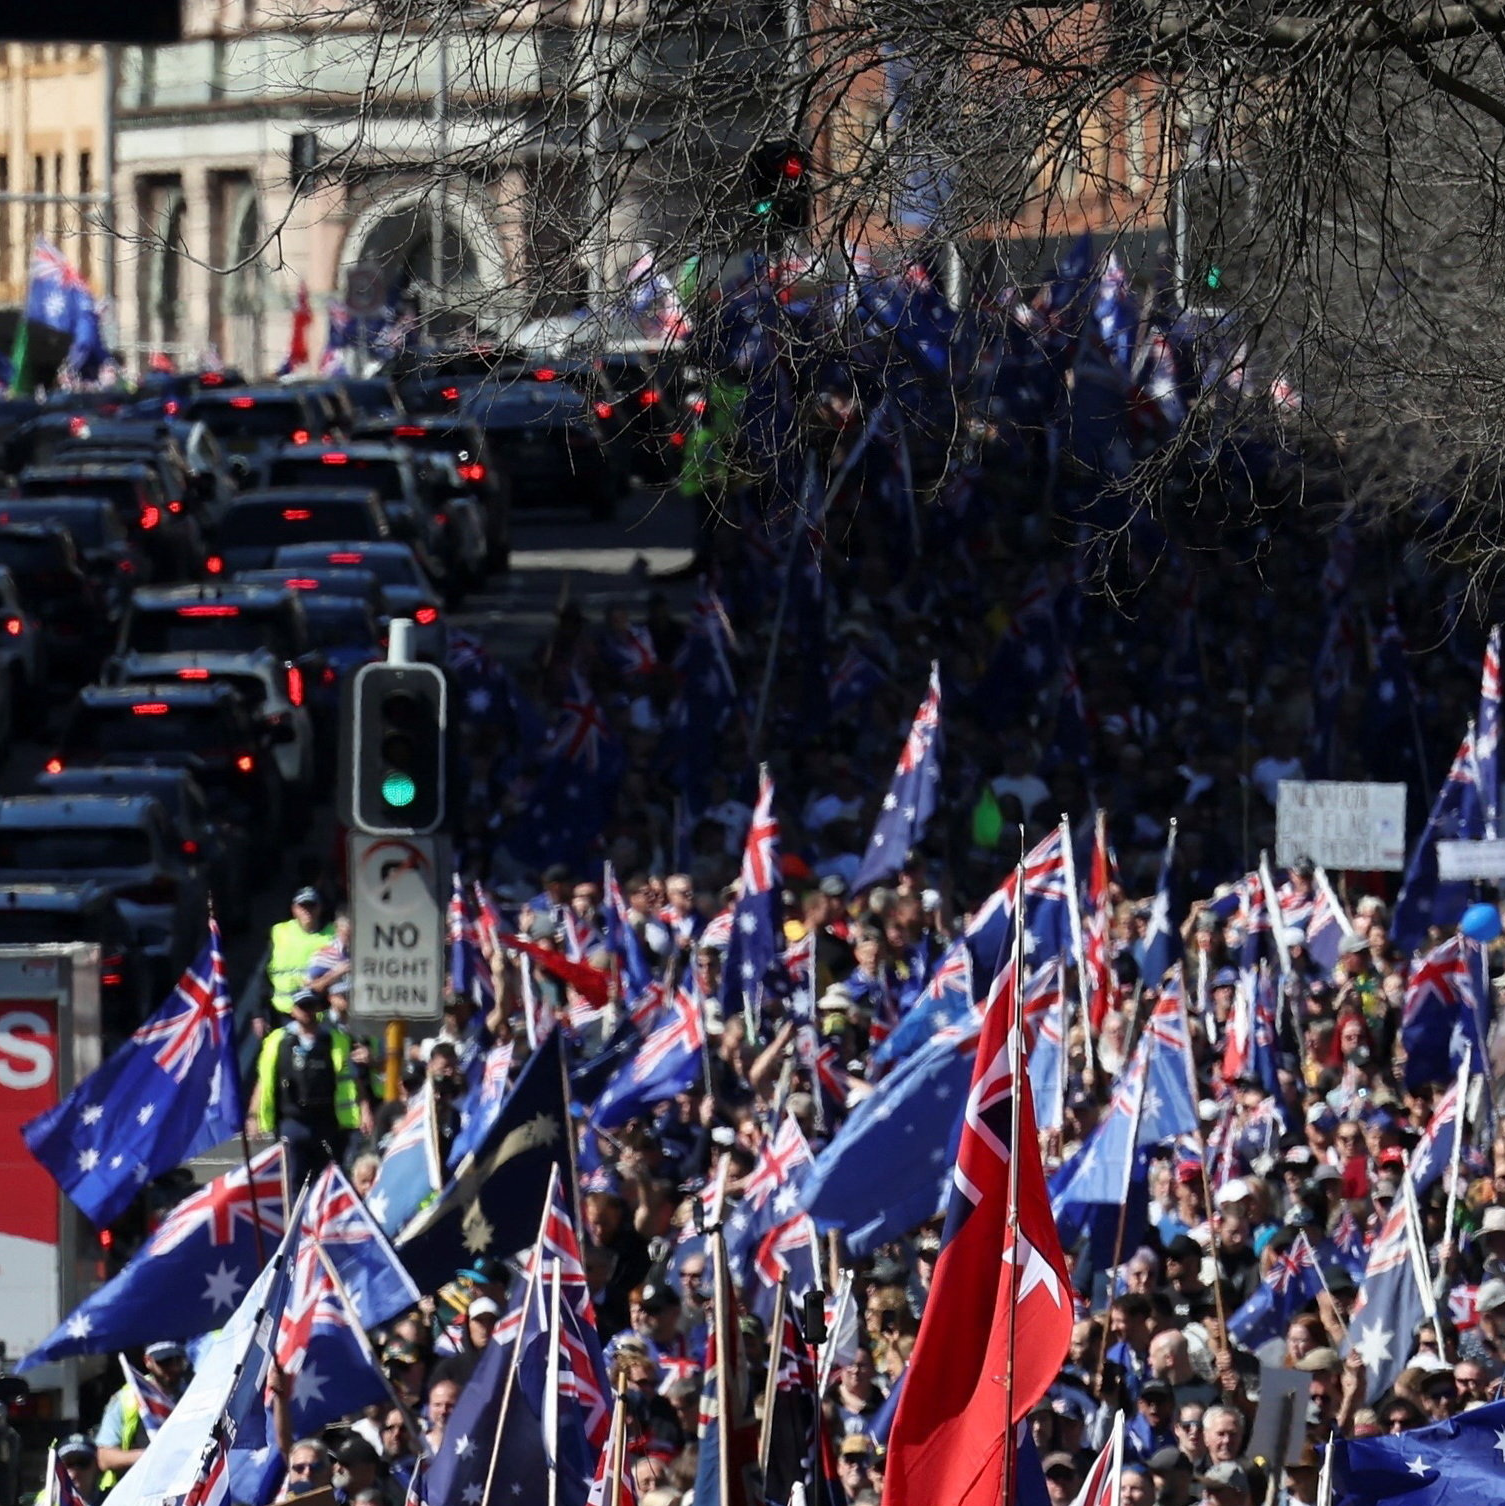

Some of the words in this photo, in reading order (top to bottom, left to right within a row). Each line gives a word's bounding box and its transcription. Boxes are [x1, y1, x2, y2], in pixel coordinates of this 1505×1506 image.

[373, 921, 419, 949] NO
[362, 956, 429, 978] RIGHT
[365, 983, 429, 1006] TURN
